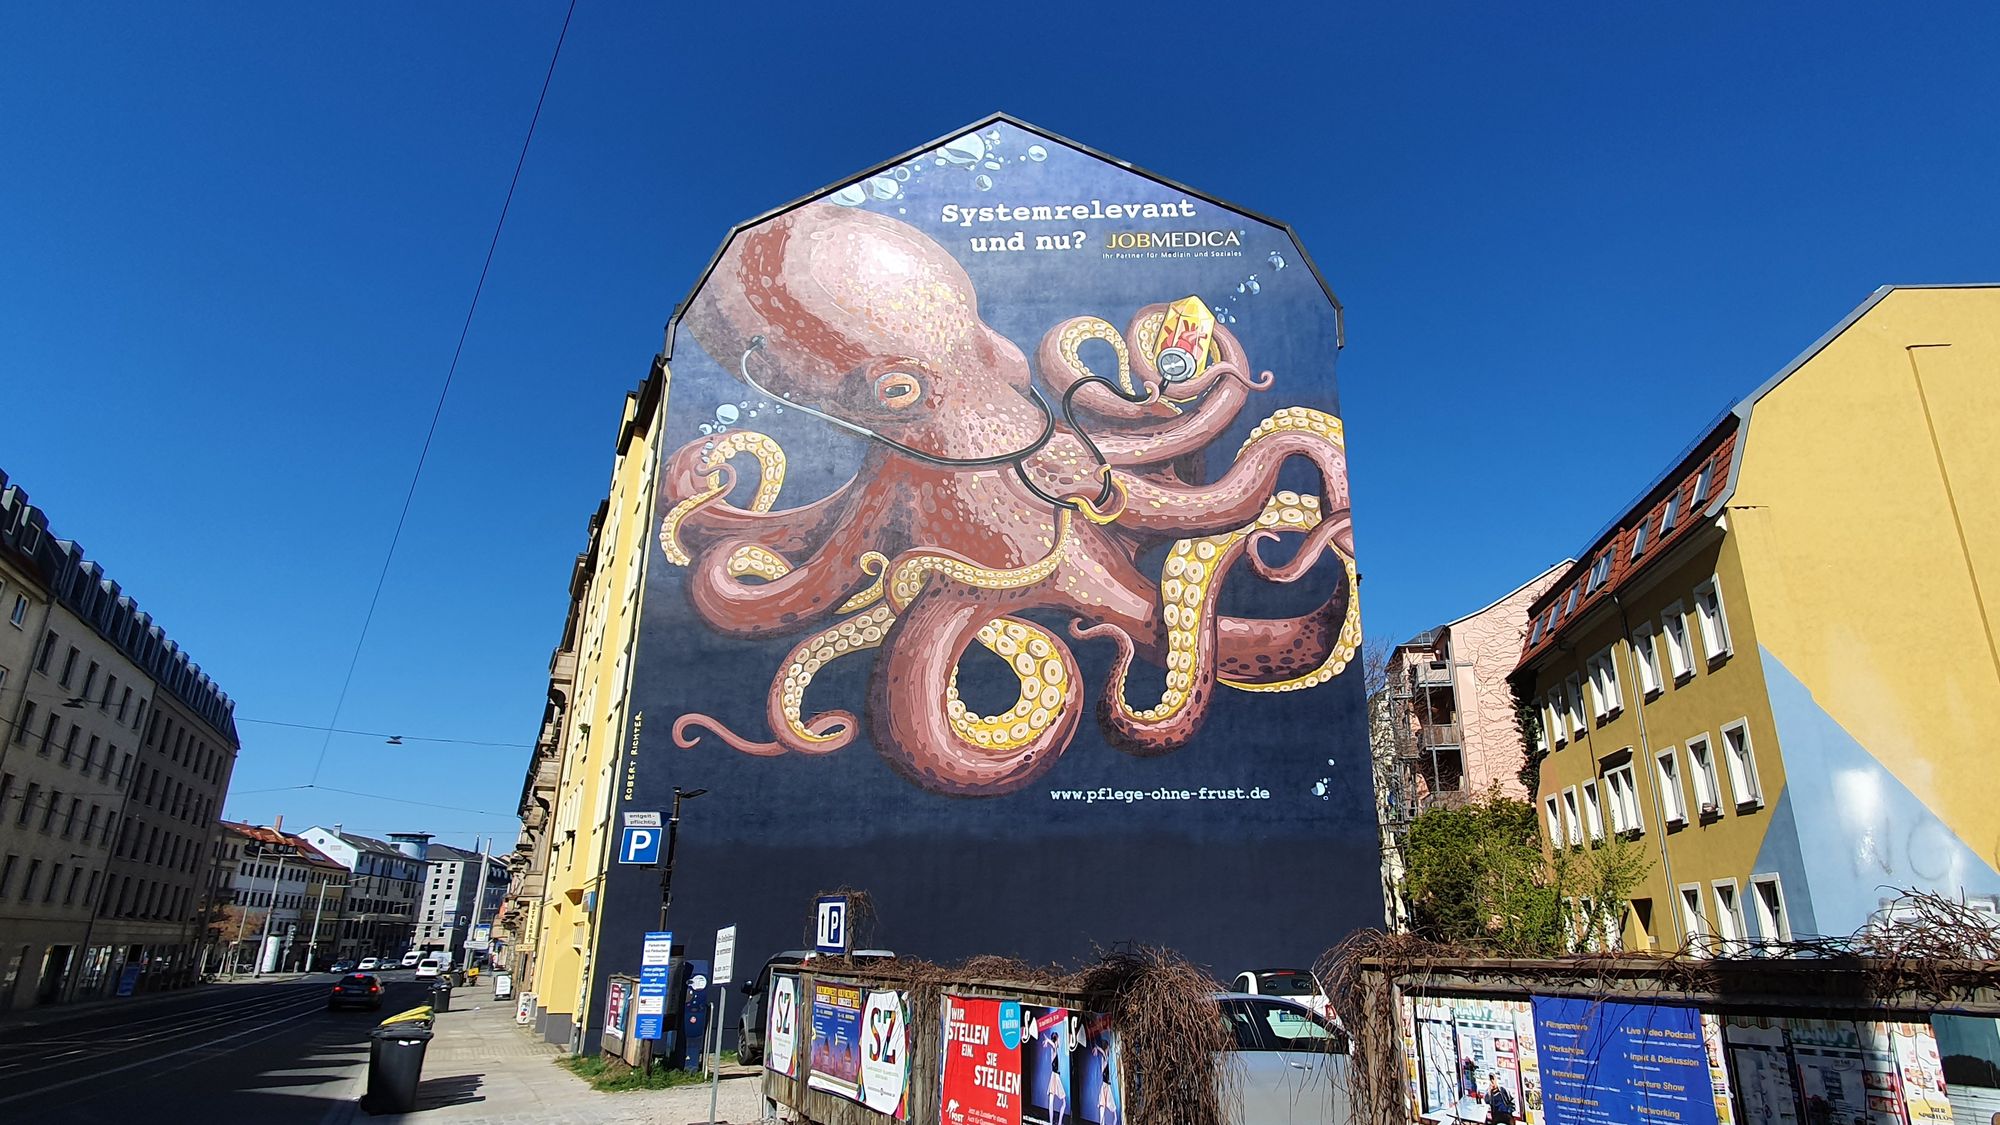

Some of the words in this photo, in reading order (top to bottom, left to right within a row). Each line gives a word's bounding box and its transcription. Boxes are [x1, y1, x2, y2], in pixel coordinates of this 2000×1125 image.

[941, 198, 1196, 227] Systemrelevant
[970, 231, 1025, 252] und
[1035, 230, 1087, 251] nu?
[1106, 230, 1241, 249] JOBMEDICA
[630, 711, 643, 756] RICHTER
[624, 760, 637, 801] ROBERT
[1050, 787, 1270, 804] www.pflege-ohne-frust.de
[628, 830, 652, 861] P
[830, 911, 839, 940] P
[776, 990, 792, 1036] SZ
[951, 1007, 965, 1020] WIR
[869, 1007, 897, 1065] SZ
[948, 1023, 990, 1046] STELLEN
[1626, 1026, 1641, 1035] Live
[1642, 1027, 1664, 1037] Vdeo
[1664, 1029, 1697, 1040] Podcast
[961, 1044, 974, 1058] EIN.
[986, 1052, 998, 1067] SIE
[1650, 1054, 1657, 1063] &
[1657, 1055, 1700, 1067] Diskussion
[974, 1066, 1021, 1096] STELLEN
[1662, 1081, 1685, 1092] Show
[996, 1093, 1009, 1109] ZU.
[1637, 1104, 1681, 1121] Neworking
